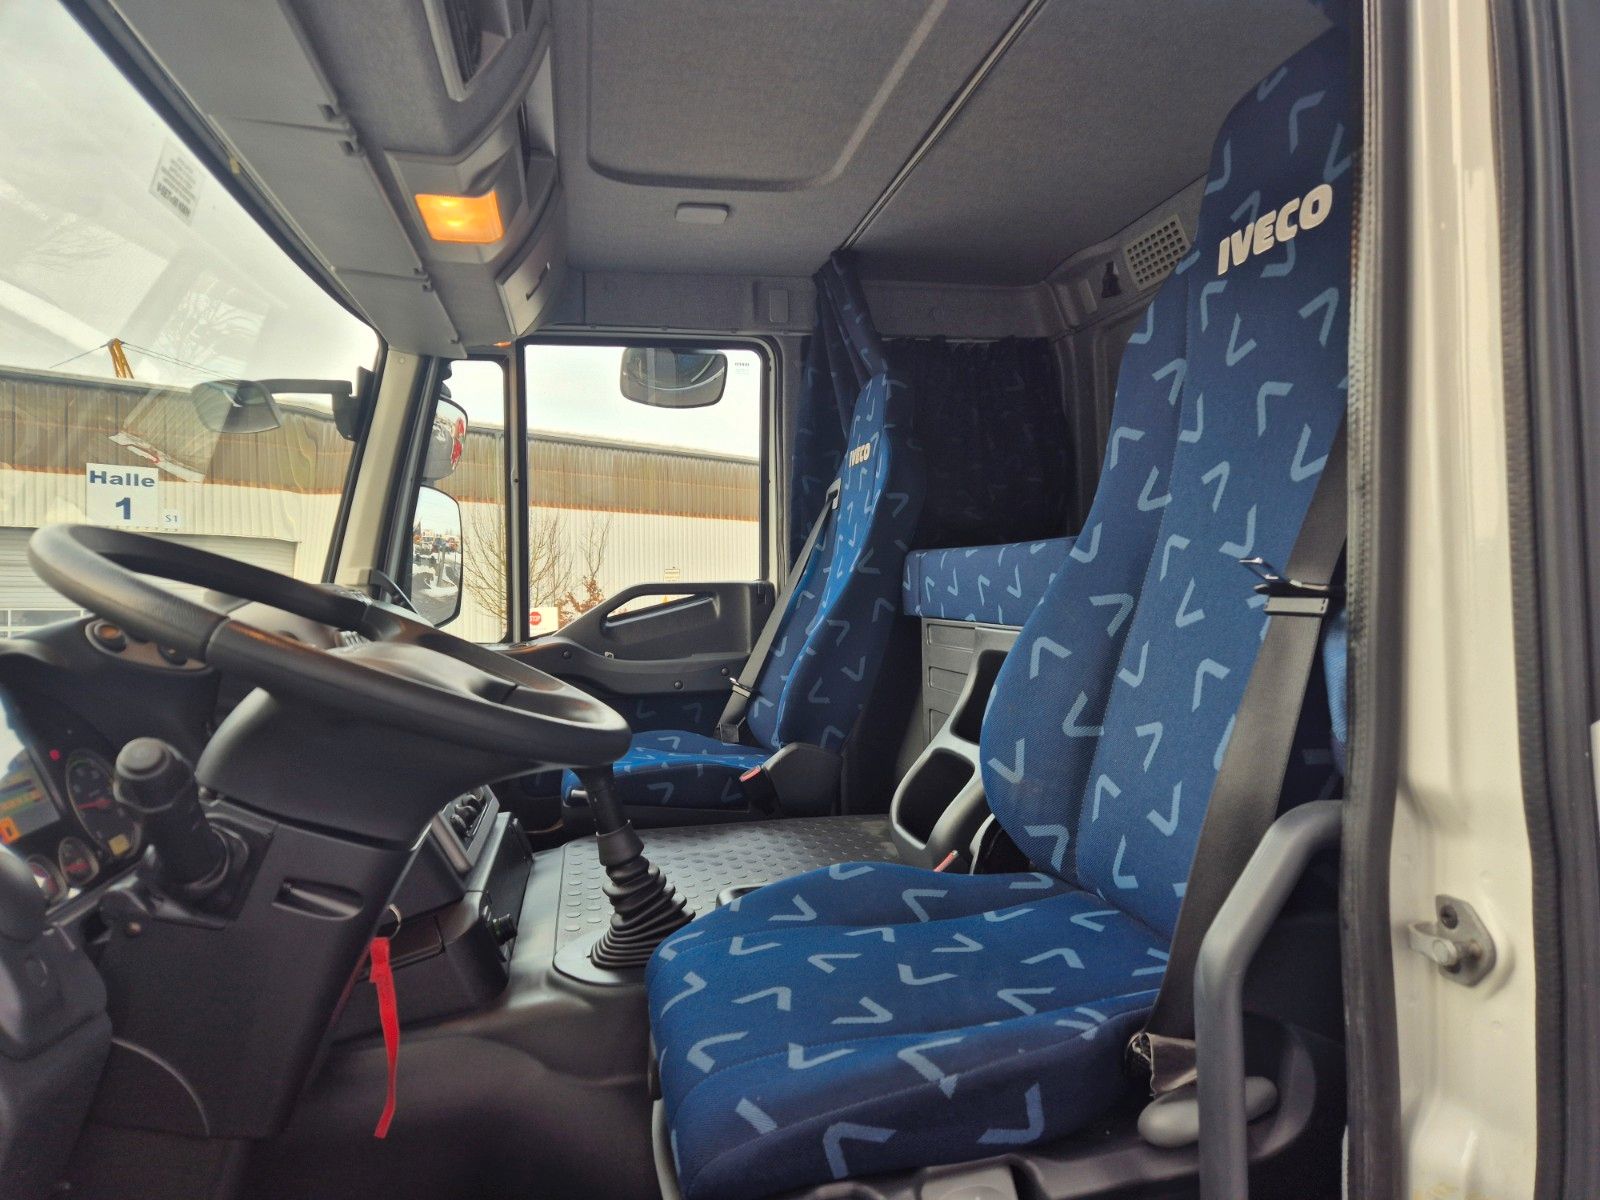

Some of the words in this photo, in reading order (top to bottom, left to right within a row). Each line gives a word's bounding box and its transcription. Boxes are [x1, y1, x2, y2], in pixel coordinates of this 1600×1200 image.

[1218, 184, 1332, 275] IVECO
[848, 442, 871, 468] IVECO
[89, 470, 155, 487] Halle
[115, 497, 131, 520] 1
